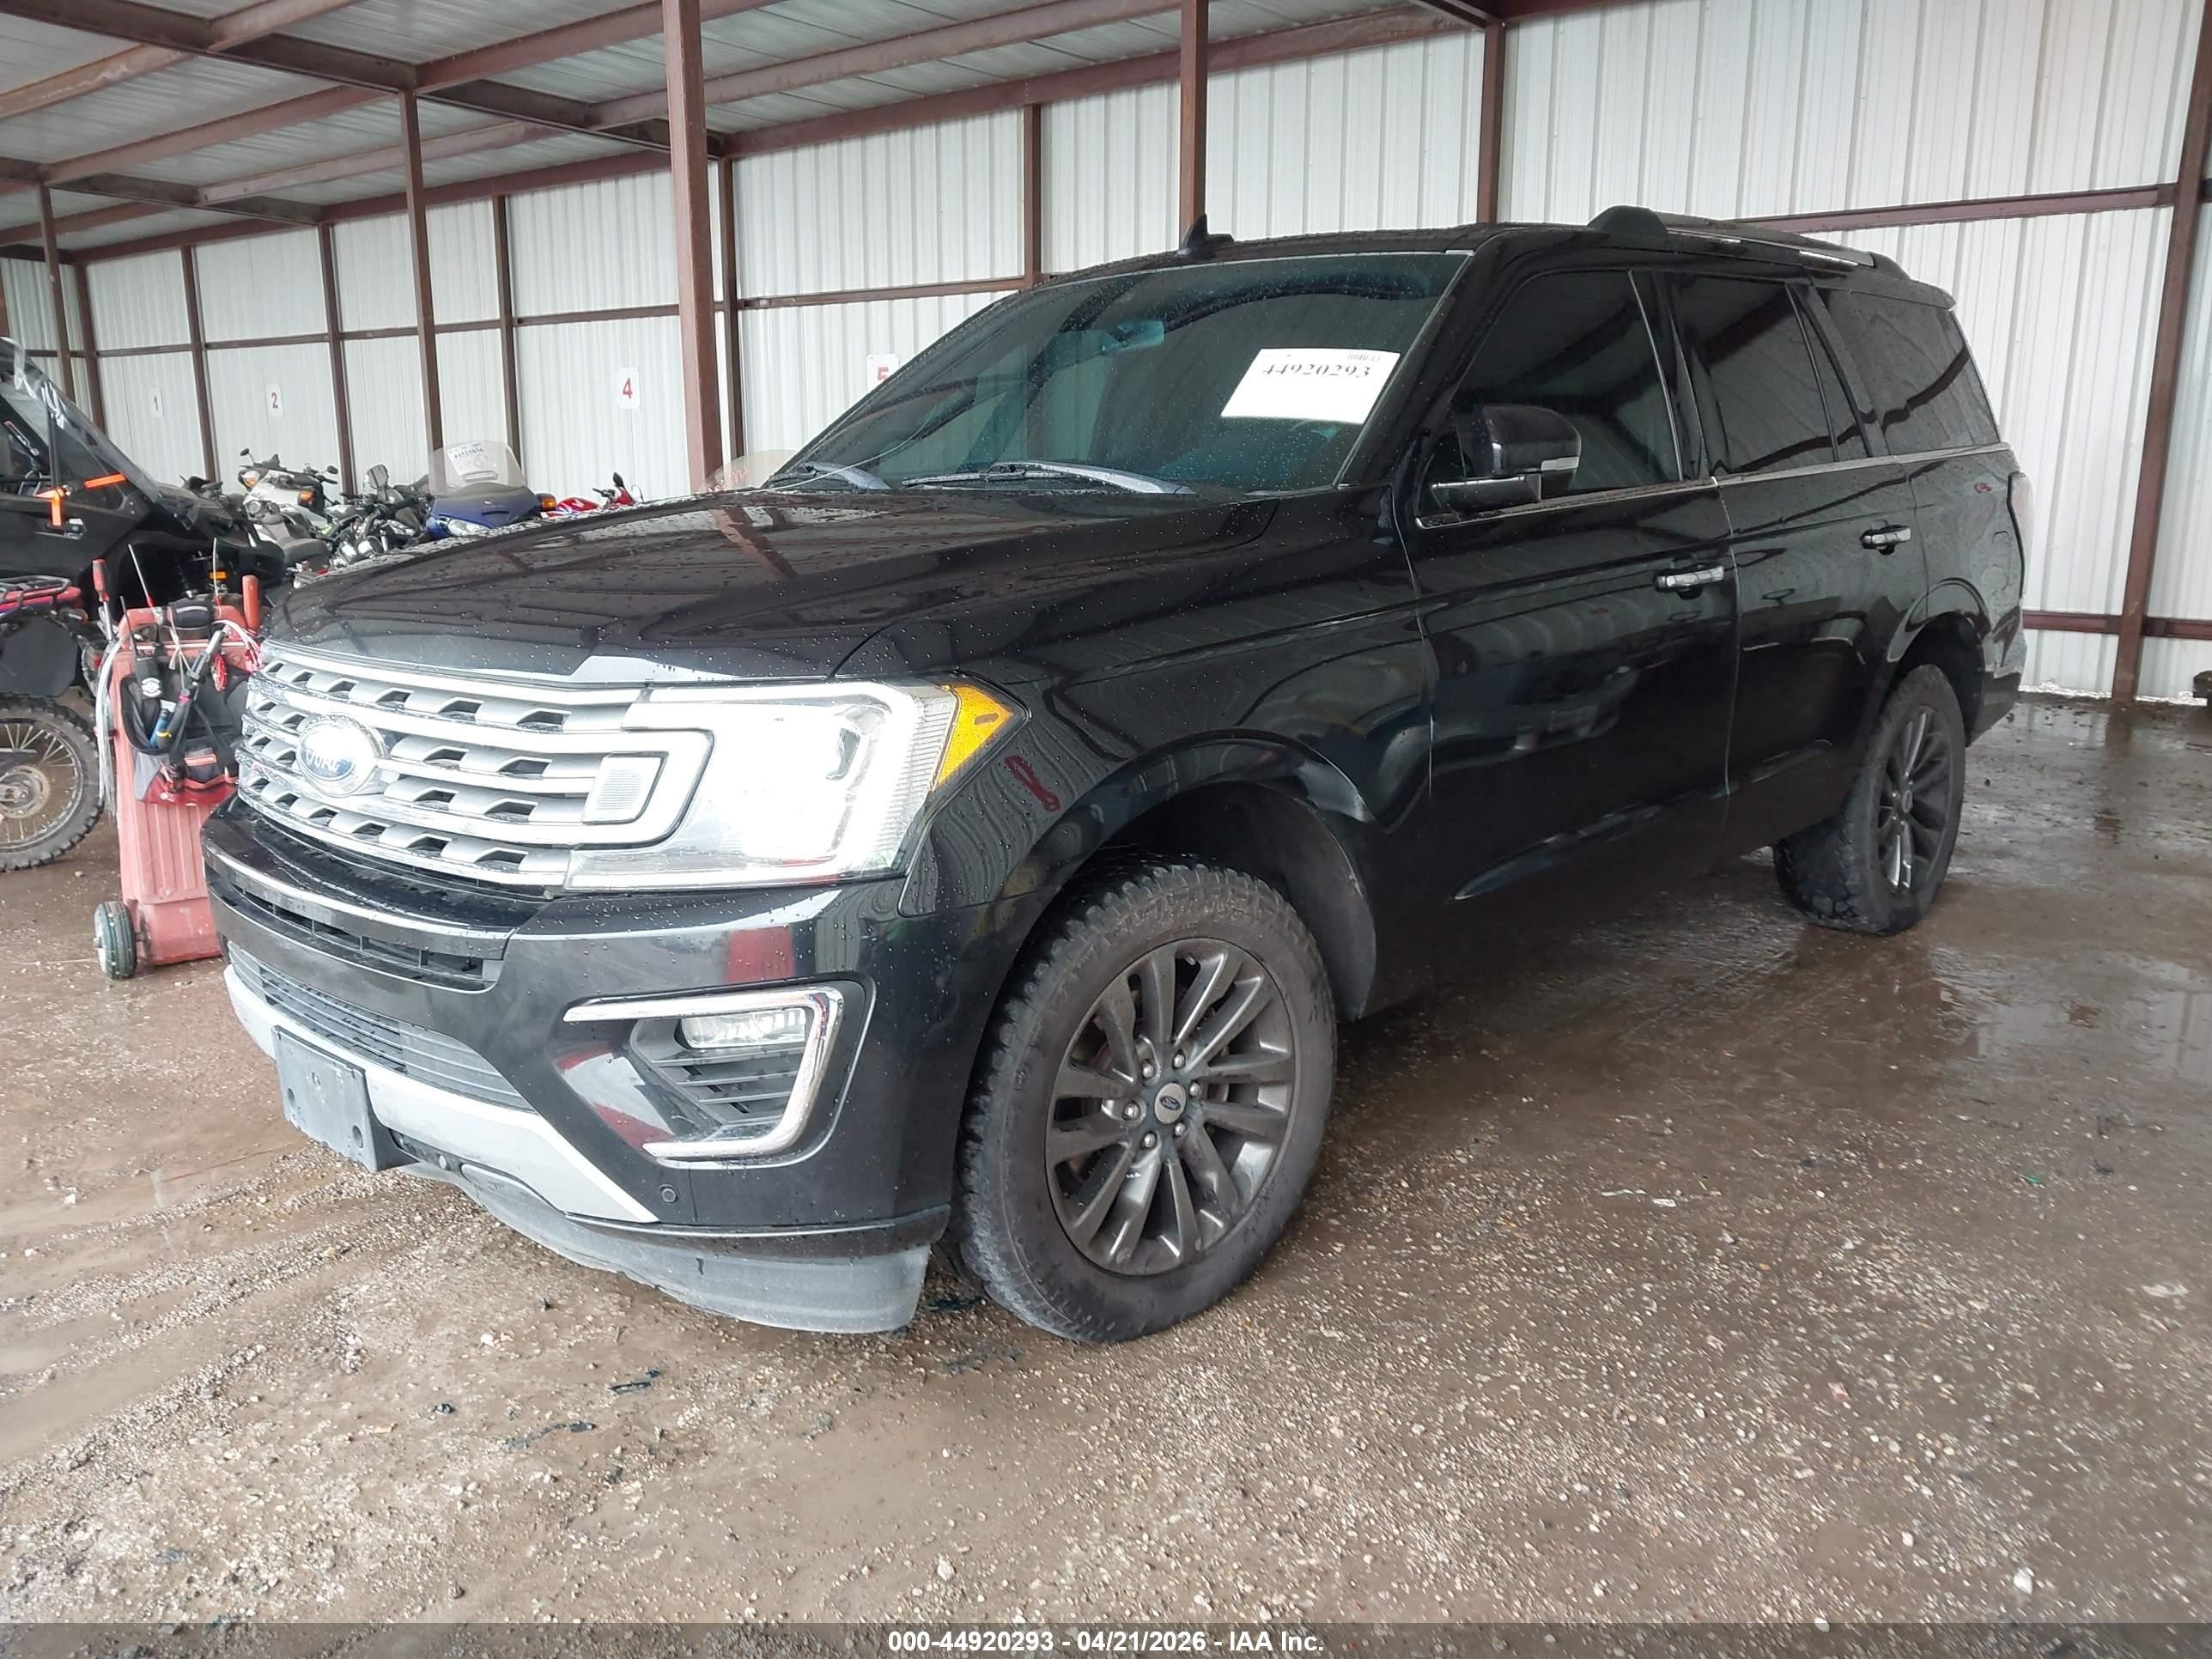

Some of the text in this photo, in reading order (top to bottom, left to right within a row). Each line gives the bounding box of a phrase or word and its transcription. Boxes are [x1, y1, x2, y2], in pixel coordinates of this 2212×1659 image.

[1262, 363, 1371, 378] 44920293
[622, 377, 633, 399] 4
[270, 392, 279, 409] 2
